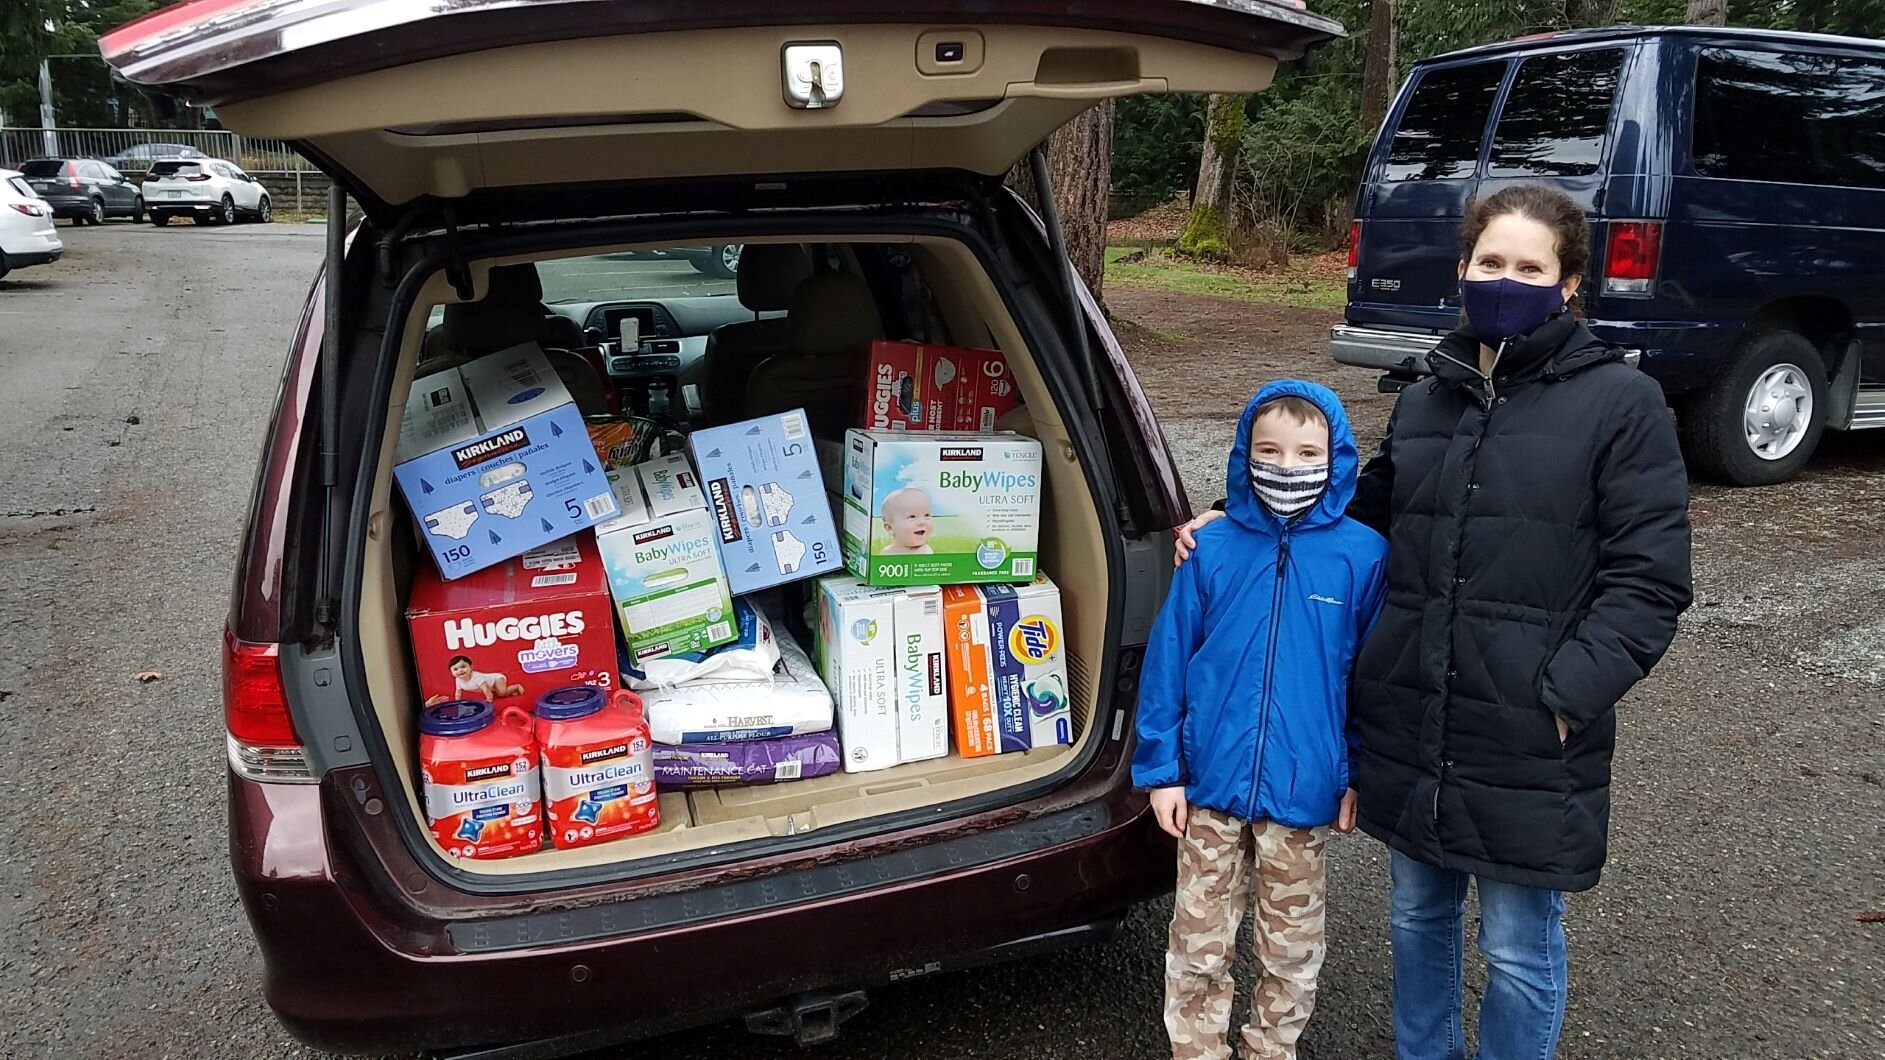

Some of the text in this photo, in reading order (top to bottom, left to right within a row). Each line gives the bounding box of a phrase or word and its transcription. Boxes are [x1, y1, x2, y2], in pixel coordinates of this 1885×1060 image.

[1372, 279, 1400, 288] E350
[983, 361, 1004, 378] 6
[991, 380, 999, 396] 120
[911, 402, 921, 422] plus
[928, 400, 937, 423] MOST
[456, 430, 524, 461] KIRKLAND
[782, 443, 802, 457] 5
[445, 443, 549, 485] diapers couches pañales
[940, 470, 1036, 493] BabyWipes
[565, 498, 582, 519] 5
[979, 494, 1035, 505] ULTRA SOFT
[711, 481, 735, 540] KIRKLAND
[635, 527, 671, 540] KIRKLAND
[744, 527, 754, 554] diapers
[442, 545, 471, 563] 150
[635, 536, 709, 563] BabyWipes
[669, 548, 711, 565] ULTRA SOFT
[812, 542, 828, 565] 150
[878, 564, 903, 578] 900
[996, 622, 1005, 649] POWER
[1018, 620, 1048, 659] Tide
[520, 646, 577, 661] movers
[637, 643, 668, 656] KIRKLAND
[597, 672, 611, 687] 3
[904, 634, 924, 722] BabyWipes
[933, 654, 941, 694] KIRKLAND
[876, 659, 887, 716] ULTRA SOFT
[979, 684, 988, 692] 4
[981, 692, 989, 712] BAGS
[1003, 696, 1012, 717] 10X
[1010, 674, 1024, 732] HYGIENIC CLEAN
[728, 715, 773, 727] HARVEST
[983, 718, 993, 732] 68
[583, 745, 627, 760] KIRKLAND
[633, 740, 644, 749] 152
[467, 765, 509, 777] KIRKLAND
[515, 761, 527, 769] 152
[662, 764, 767, 776] MAINTENANCE CAT
[570, 763, 642, 786] UltraClean
[453, 784, 524, 803] UltraClean
